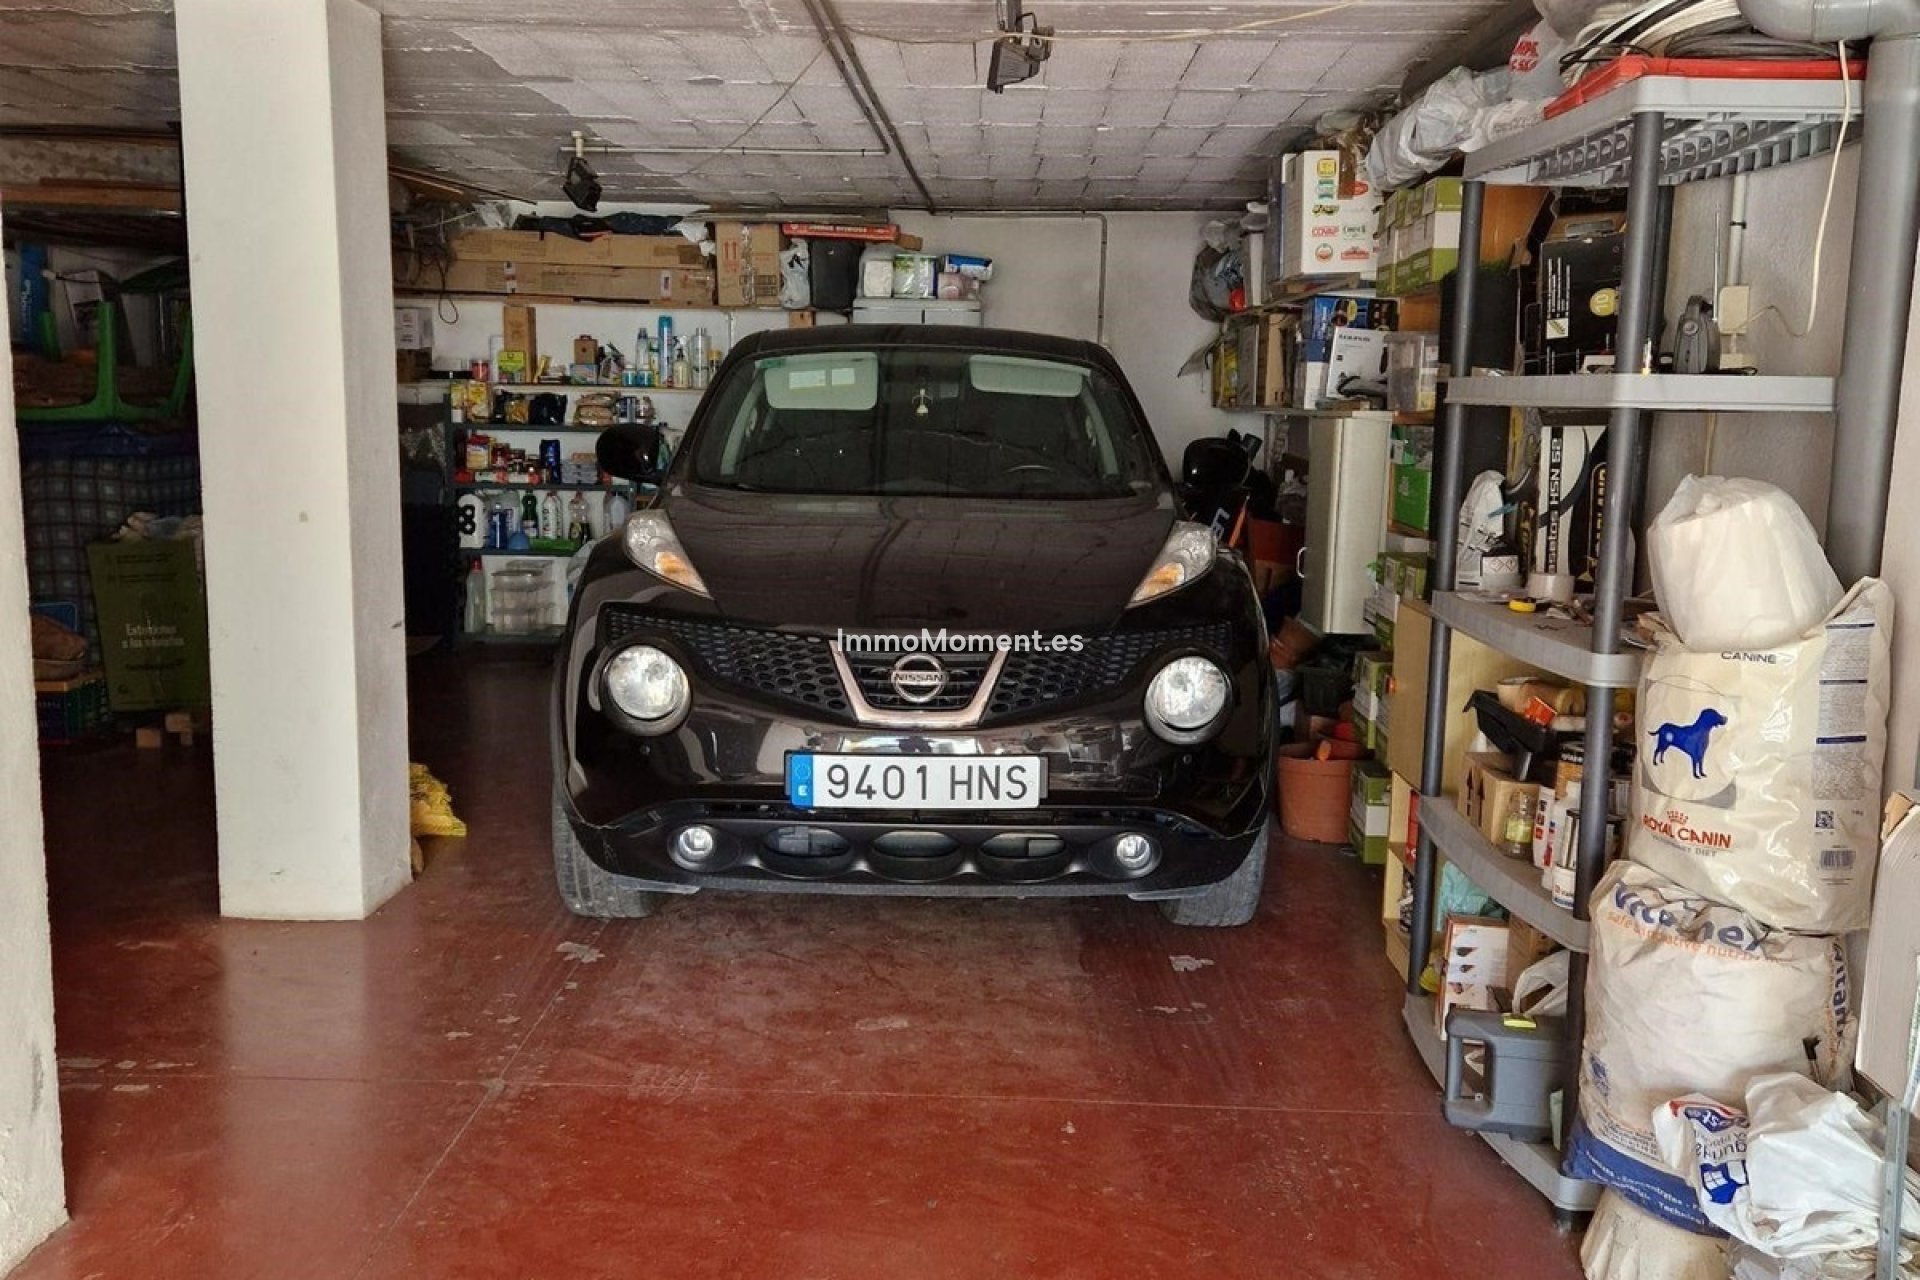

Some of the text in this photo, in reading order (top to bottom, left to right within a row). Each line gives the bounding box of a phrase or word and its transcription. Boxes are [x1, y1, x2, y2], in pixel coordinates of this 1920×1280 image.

[1549, 468, 1560, 505] HSN
[1720, 650, 1777, 665] CANINE
[894, 672, 944, 683] NISSAN
[797, 786, 808, 797] E
[827, 764, 1028, 801] 9401 HNS
[1642, 813, 1675, 838] ROYAL
[1678, 827, 1731, 848] CANIN
